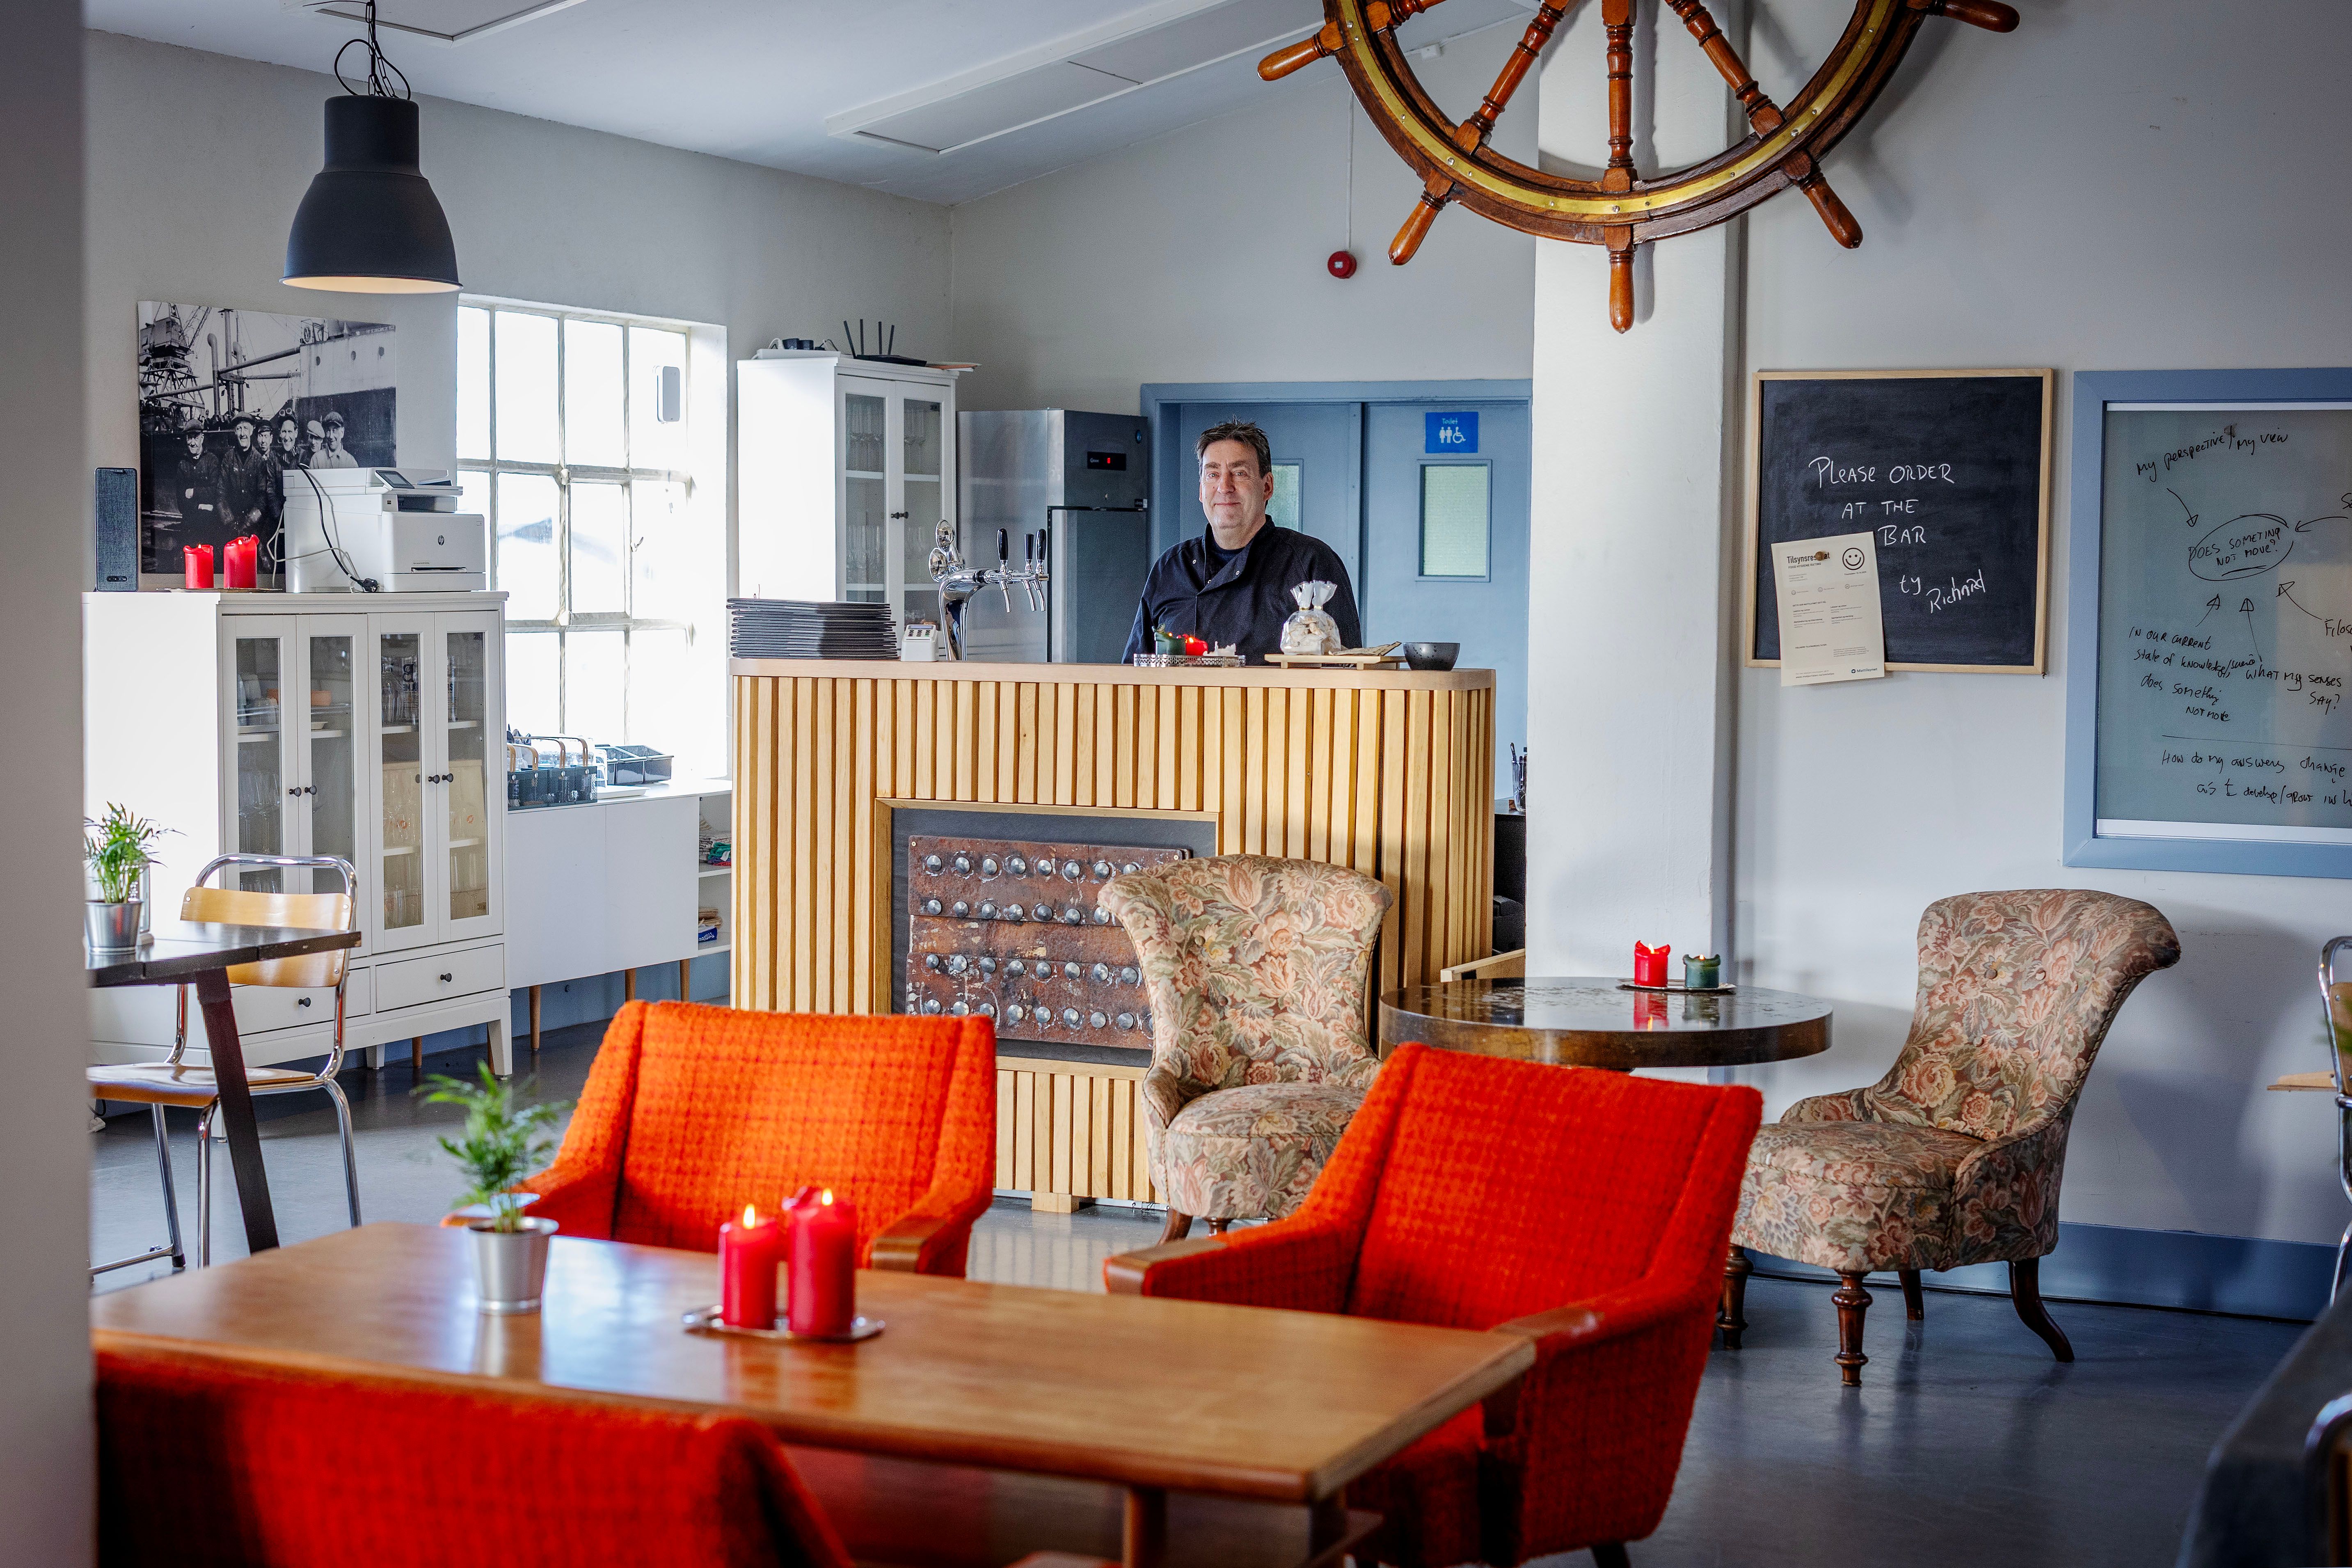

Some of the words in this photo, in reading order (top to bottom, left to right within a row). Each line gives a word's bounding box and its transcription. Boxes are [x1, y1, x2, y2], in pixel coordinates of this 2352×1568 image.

[1889, 463, 1955, 484] ORDER
[1842, 502, 1867, 519] AT
[1881, 499, 1919, 515] THE
[1877, 525, 1926, 546] BAR
[1787, 552, 1830, 564] Tilsynsresat
[2188, 544, 2220, 561] DOES
[2217, 554, 2236, 565] NOT
[2163, 653, 2175, 666] of
[2192, 752, 2203, 763] do
